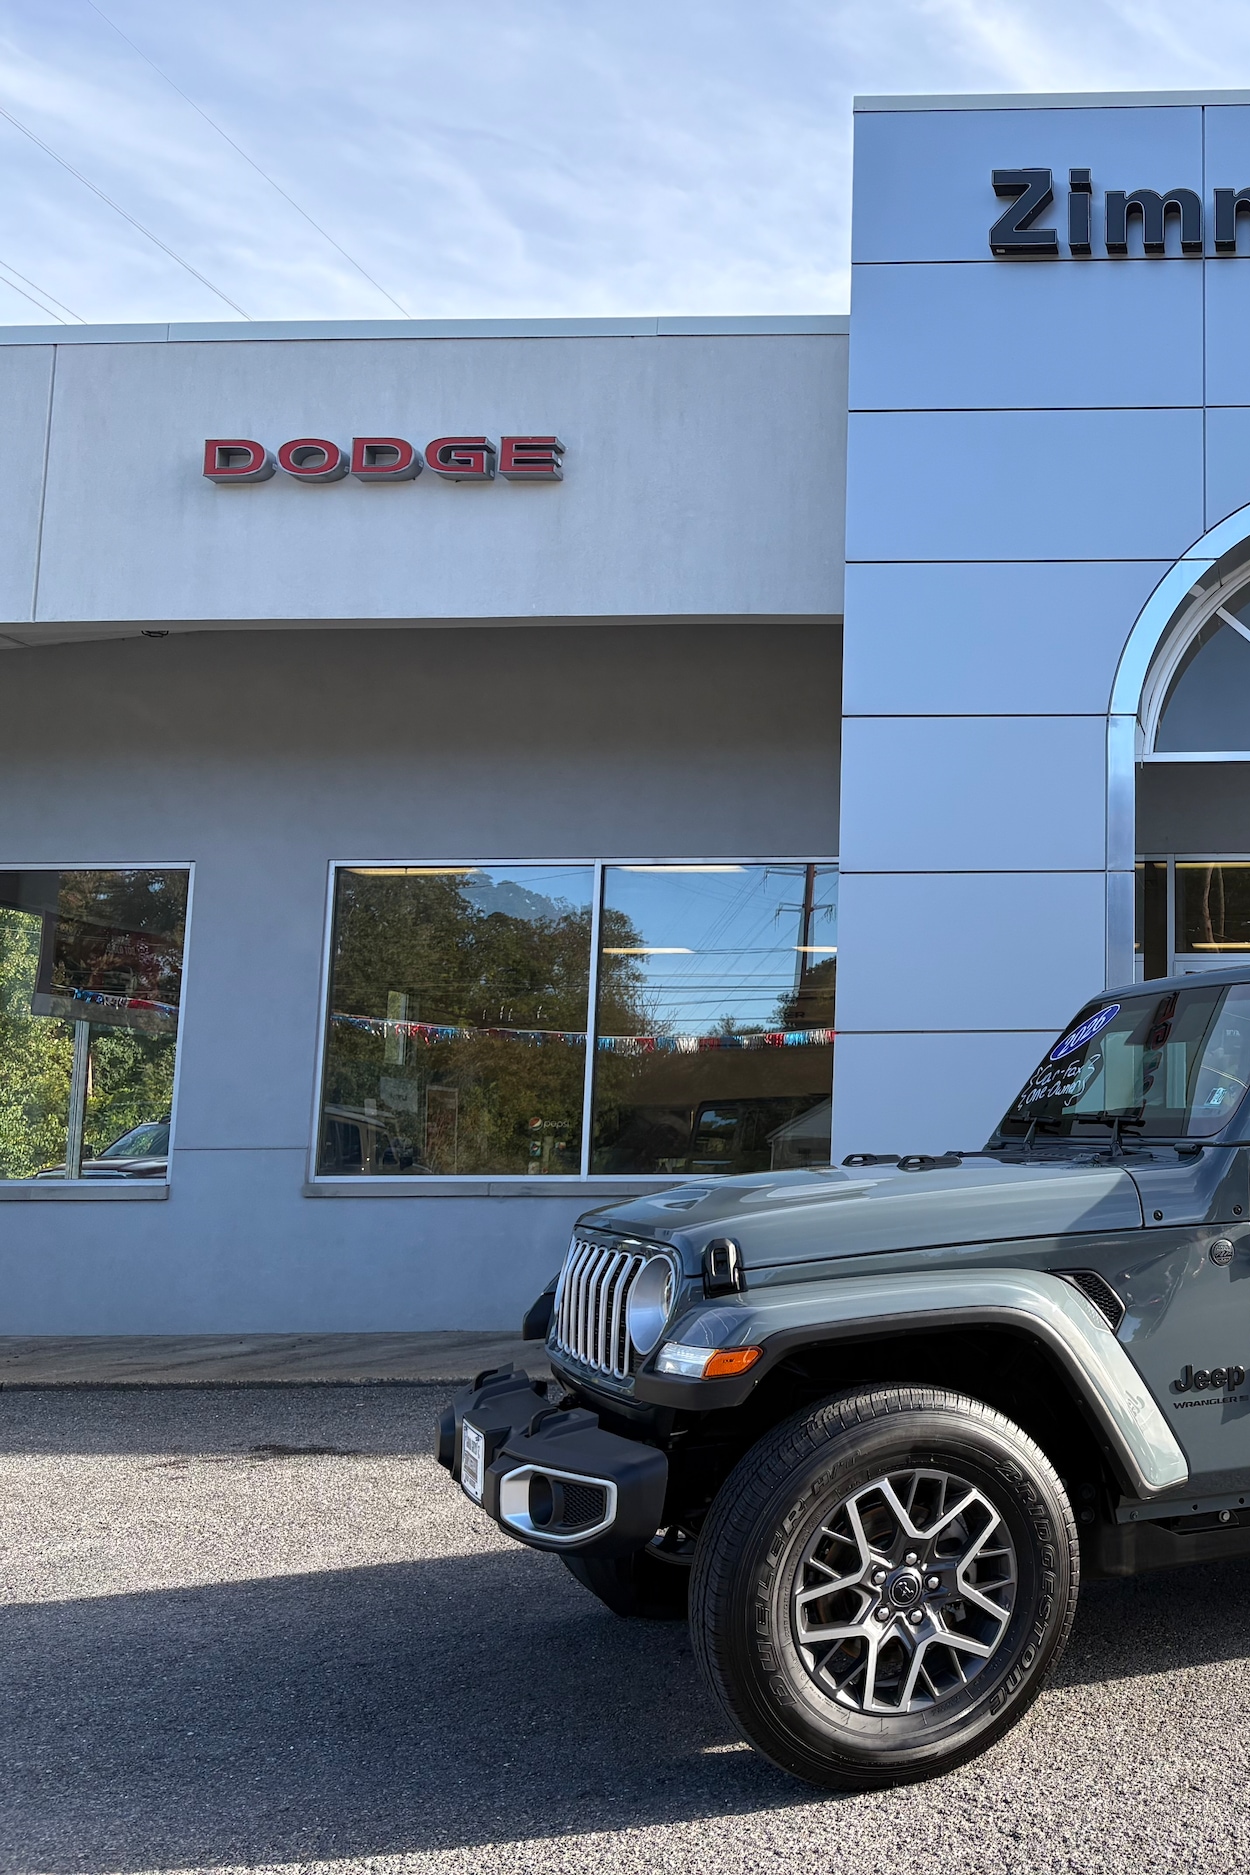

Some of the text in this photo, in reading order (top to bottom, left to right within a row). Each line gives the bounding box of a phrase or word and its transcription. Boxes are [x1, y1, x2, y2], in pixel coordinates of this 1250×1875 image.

[203, 435, 565, 483] DODGE
[1057, 1007, 1111, 1057] 2026
[1172, 1396, 1238, 1410] WRANGLER
[1174, 1364, 1245, 1393] Jeep
[755, 1497, 807, 1707] DUELER
[991, 1459, 1057, 1716] BRIDGESTONE
